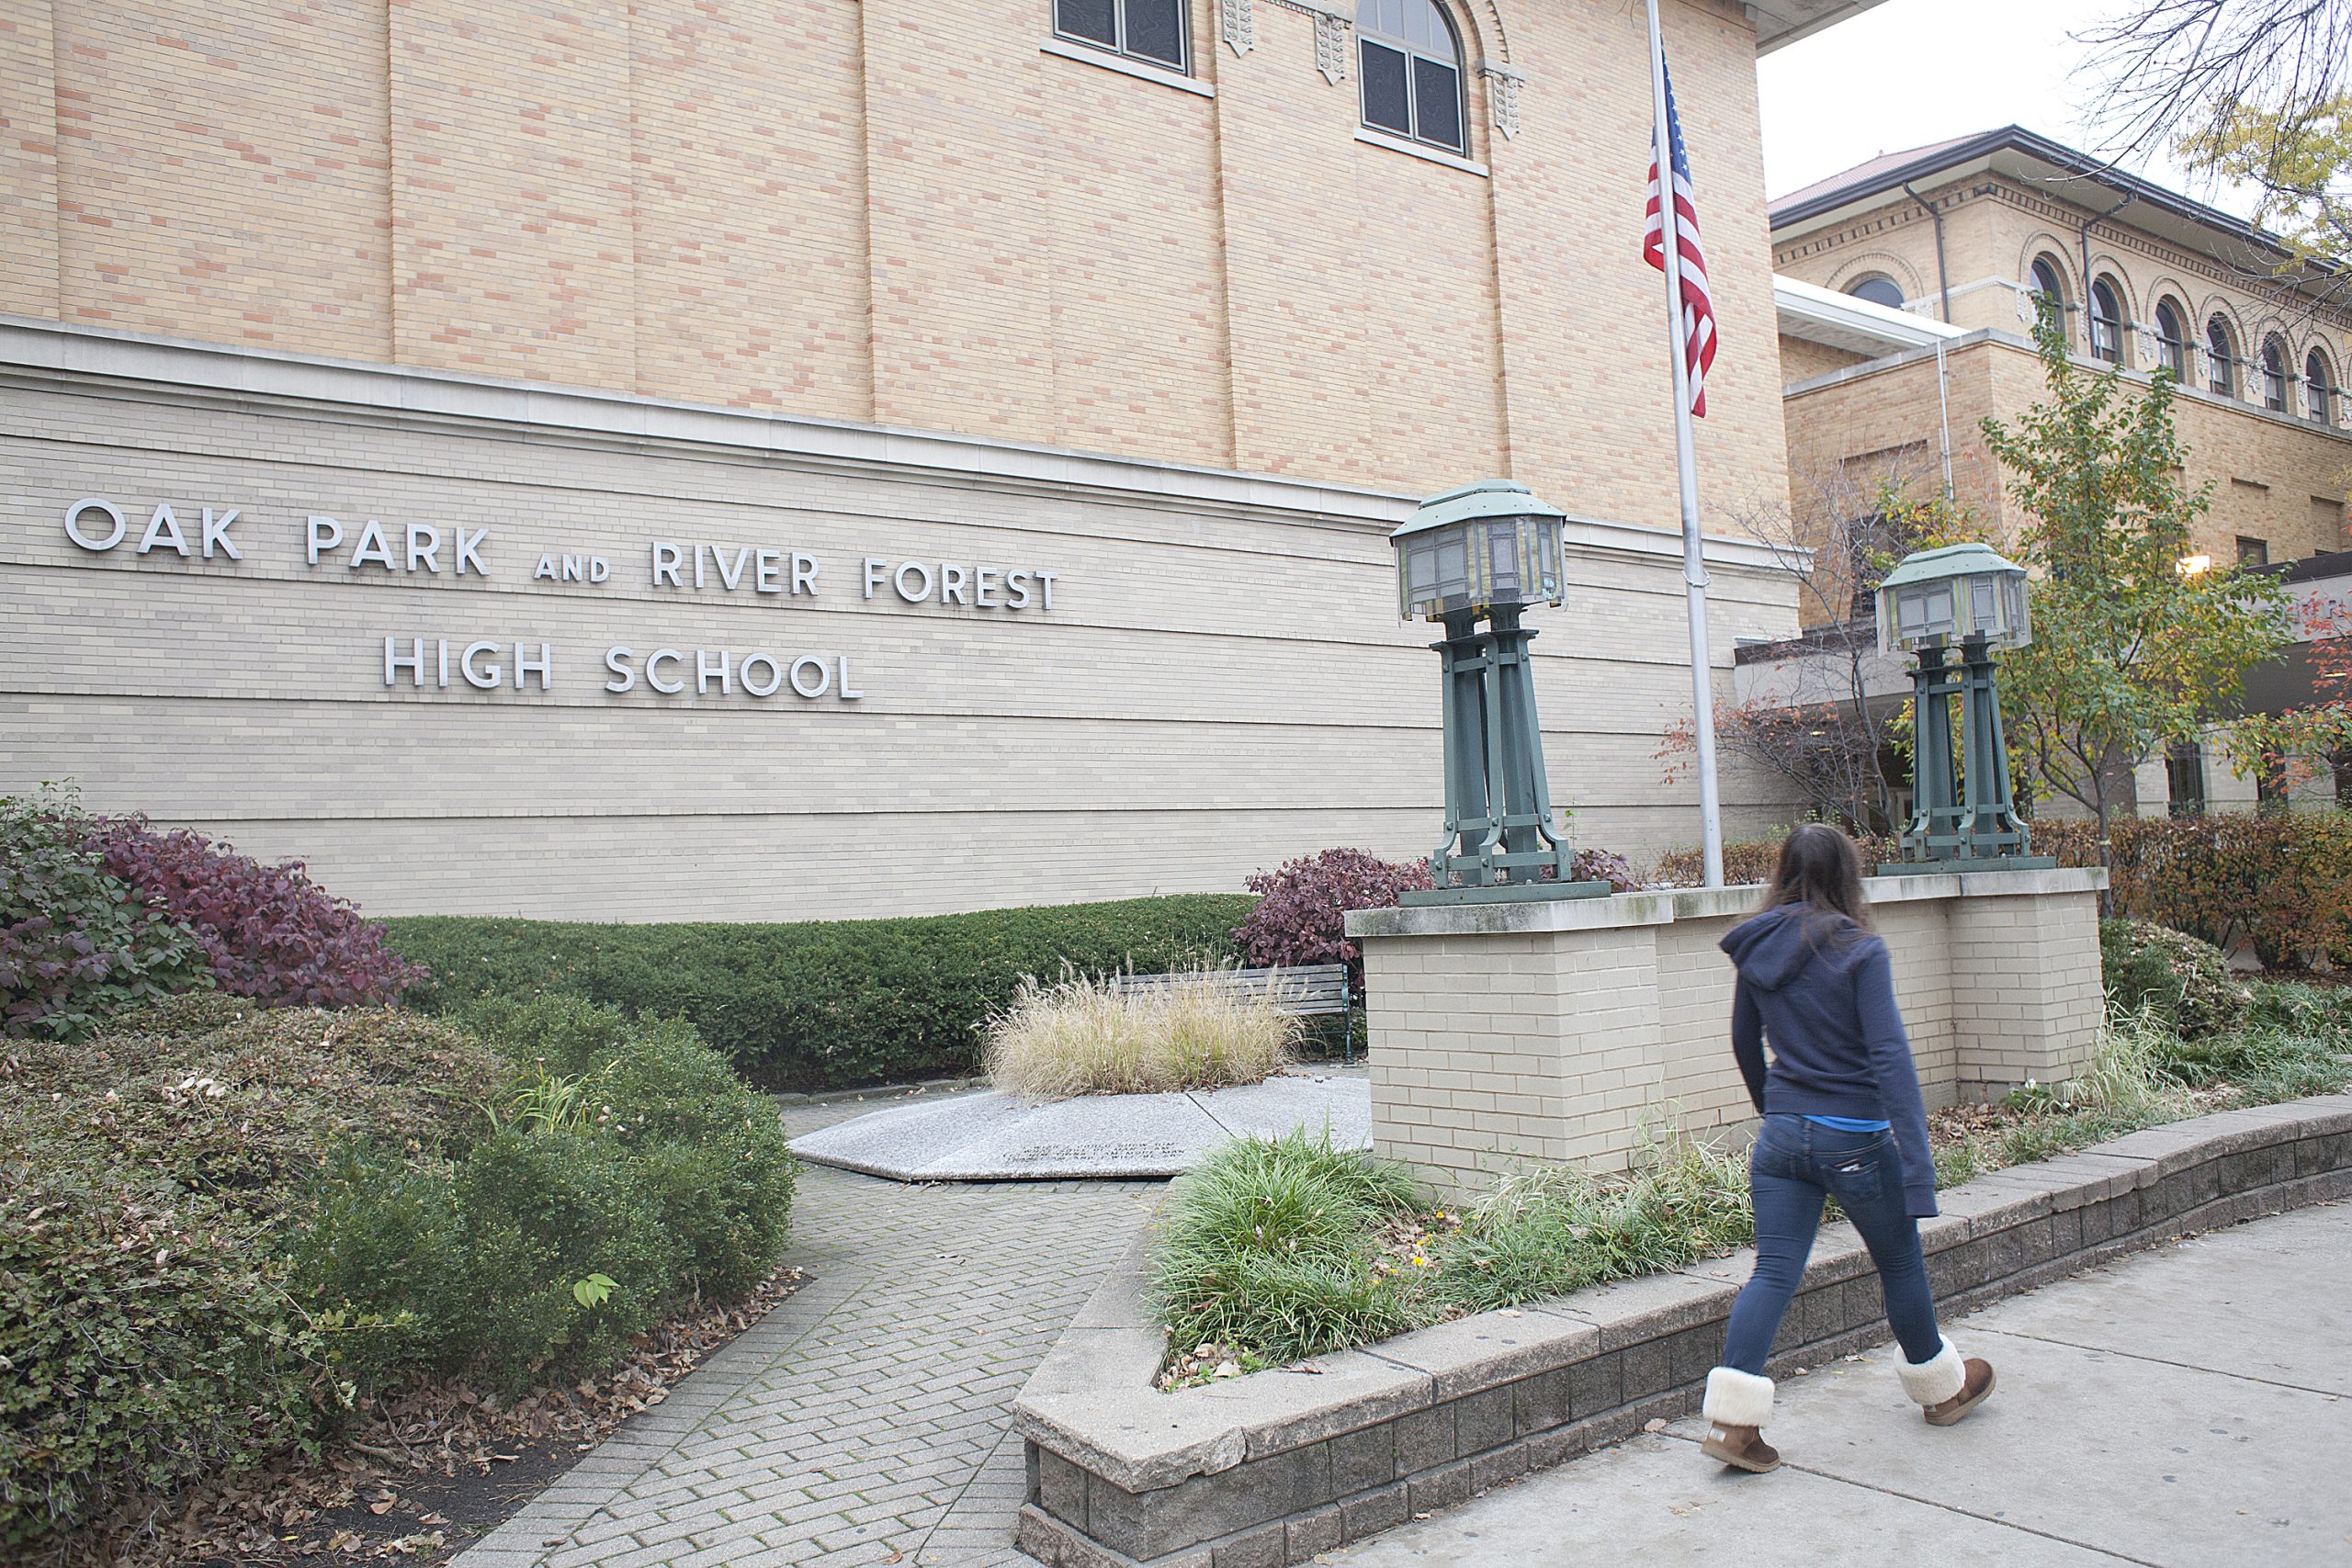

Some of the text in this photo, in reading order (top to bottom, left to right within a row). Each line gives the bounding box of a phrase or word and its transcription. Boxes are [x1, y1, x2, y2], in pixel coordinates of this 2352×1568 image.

[63, 497, 1058, 611] OAK PARK AND RIVER FOREST
[383, 636, 865, 699] HIGH SCHOOL
